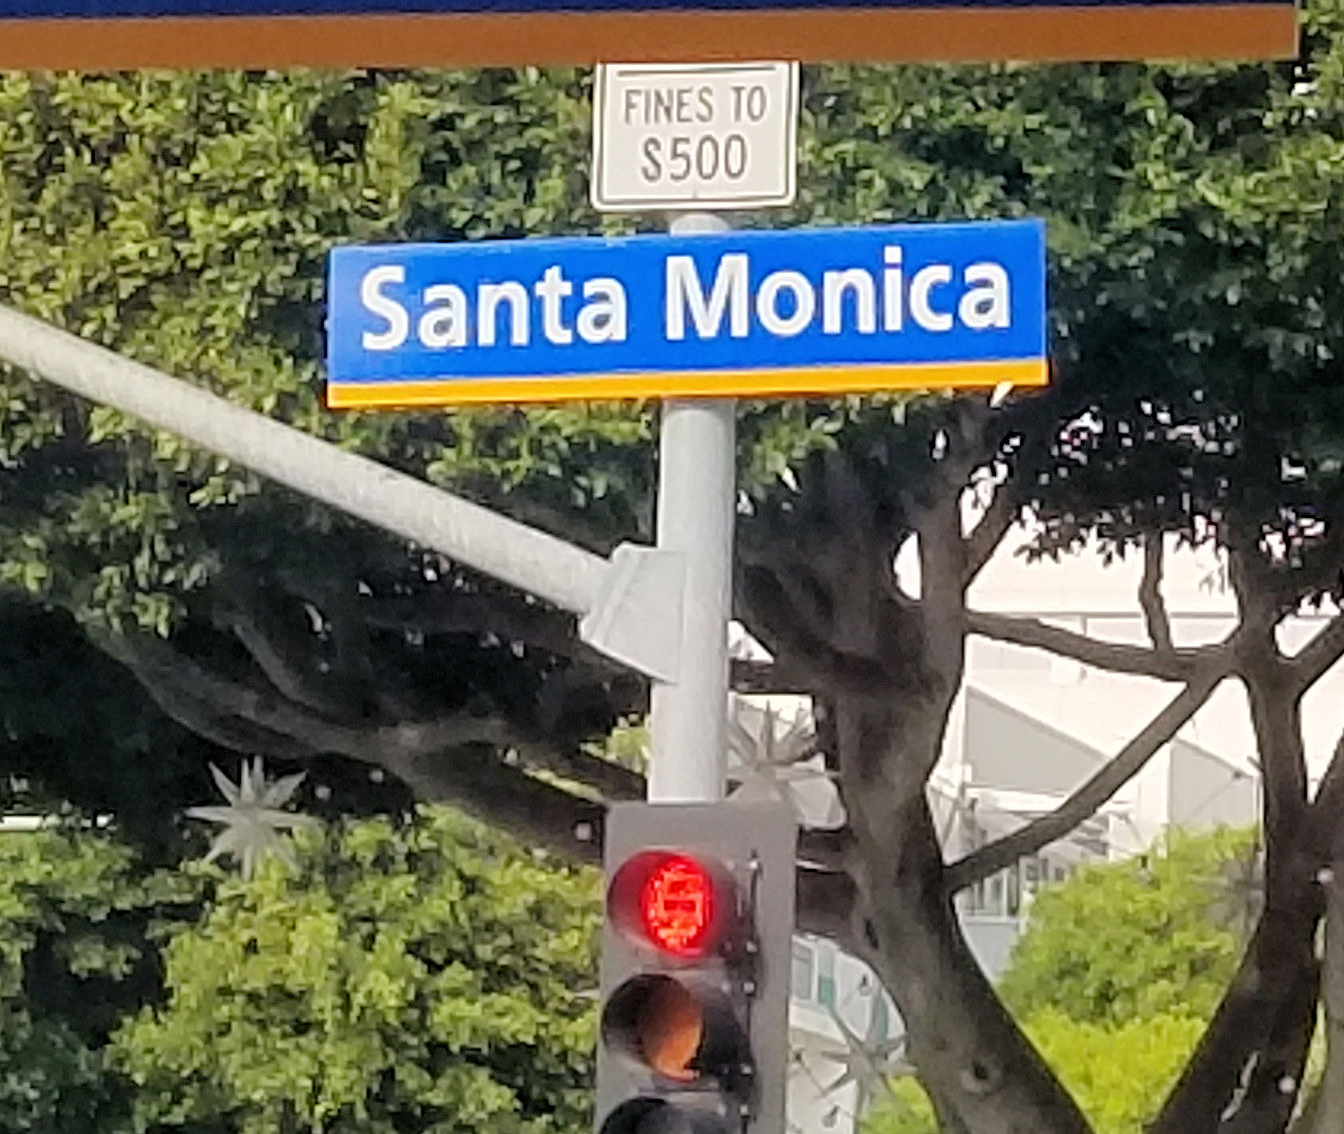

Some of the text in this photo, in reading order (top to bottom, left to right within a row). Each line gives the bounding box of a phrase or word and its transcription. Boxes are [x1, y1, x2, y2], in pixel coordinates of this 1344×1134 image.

[623, 84, 767, 125] FINES TO
[359, 245, 1011, 352] Santa Monica
